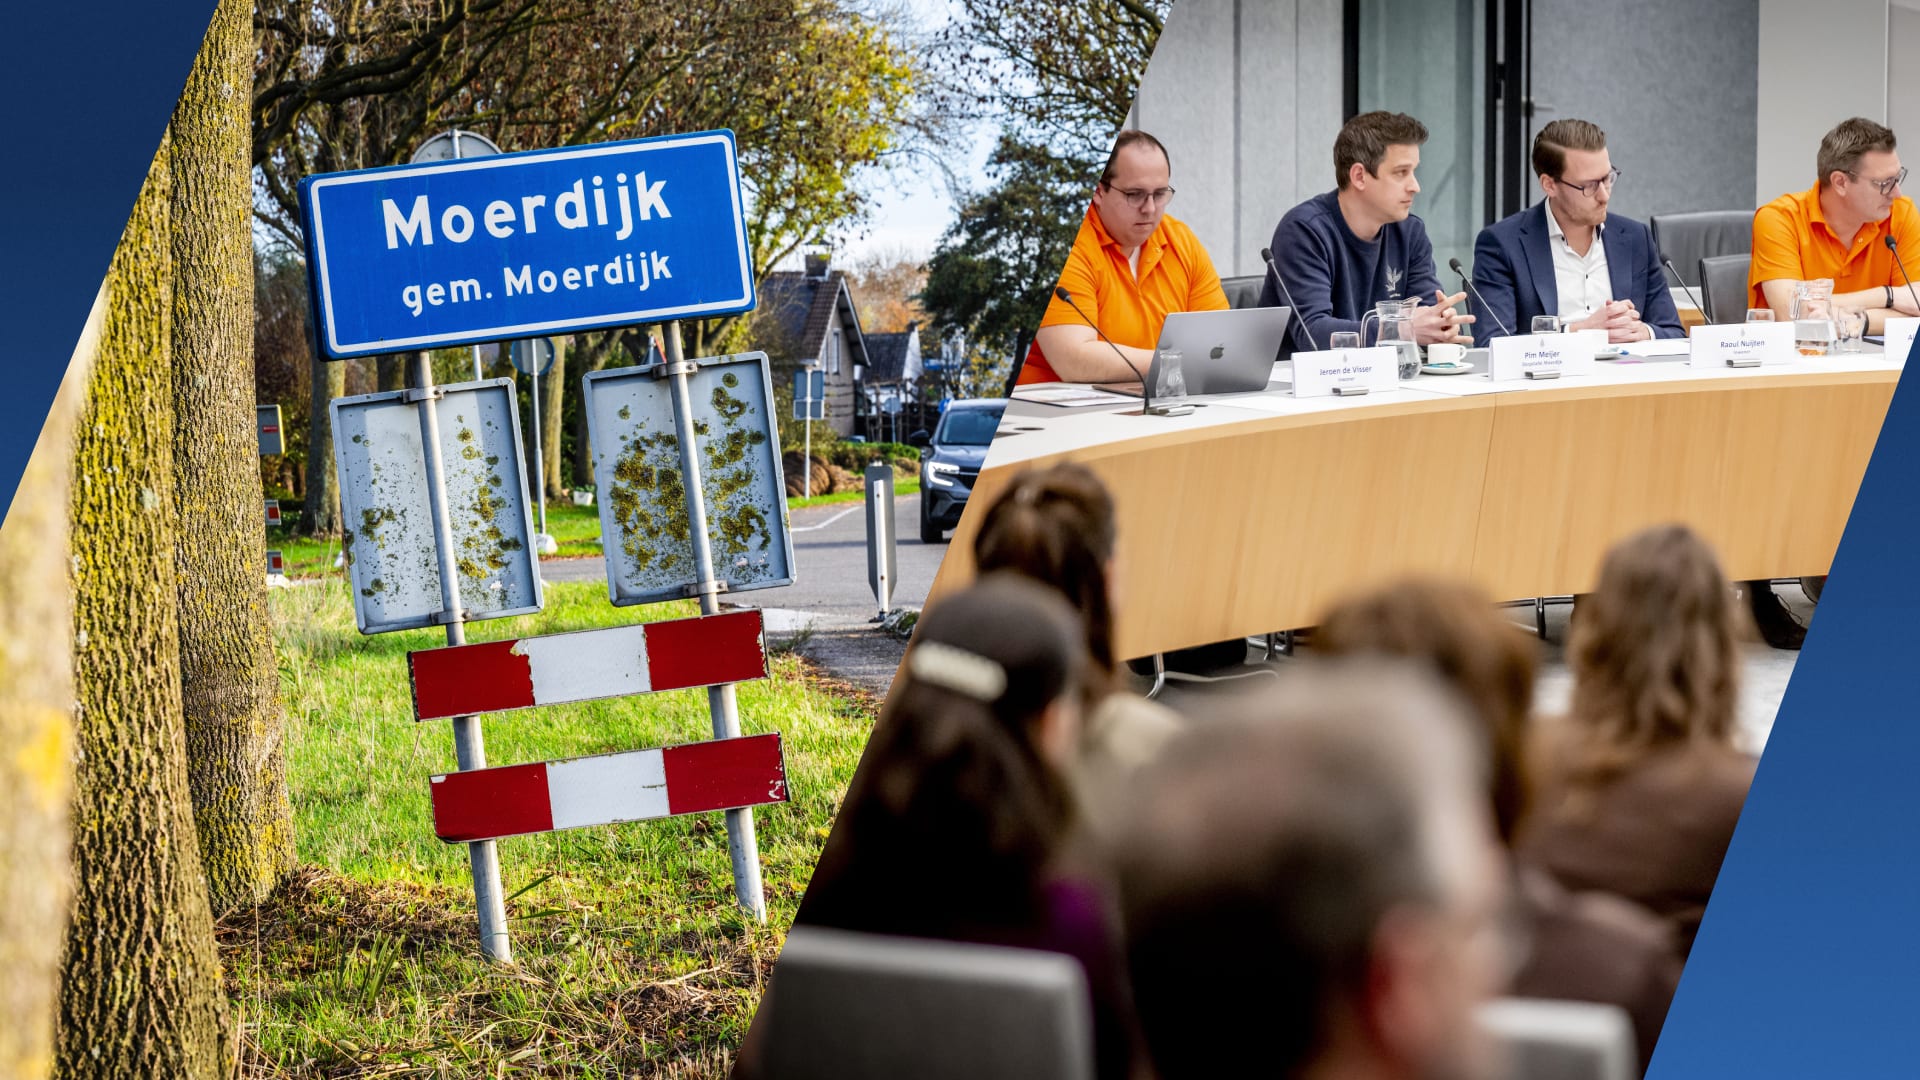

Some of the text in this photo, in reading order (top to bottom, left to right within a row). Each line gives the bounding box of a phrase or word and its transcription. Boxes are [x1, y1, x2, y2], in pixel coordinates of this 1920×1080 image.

[382, 170, 673, 250] Moerdijk
[402, 250, 673, 317] gem. Moerdijk
[1319, 368, 1341, 376] Jeroen
[1352, 366, 1372, 374] Visser
[1524, 350, 1560, 359] Pim Meijer
